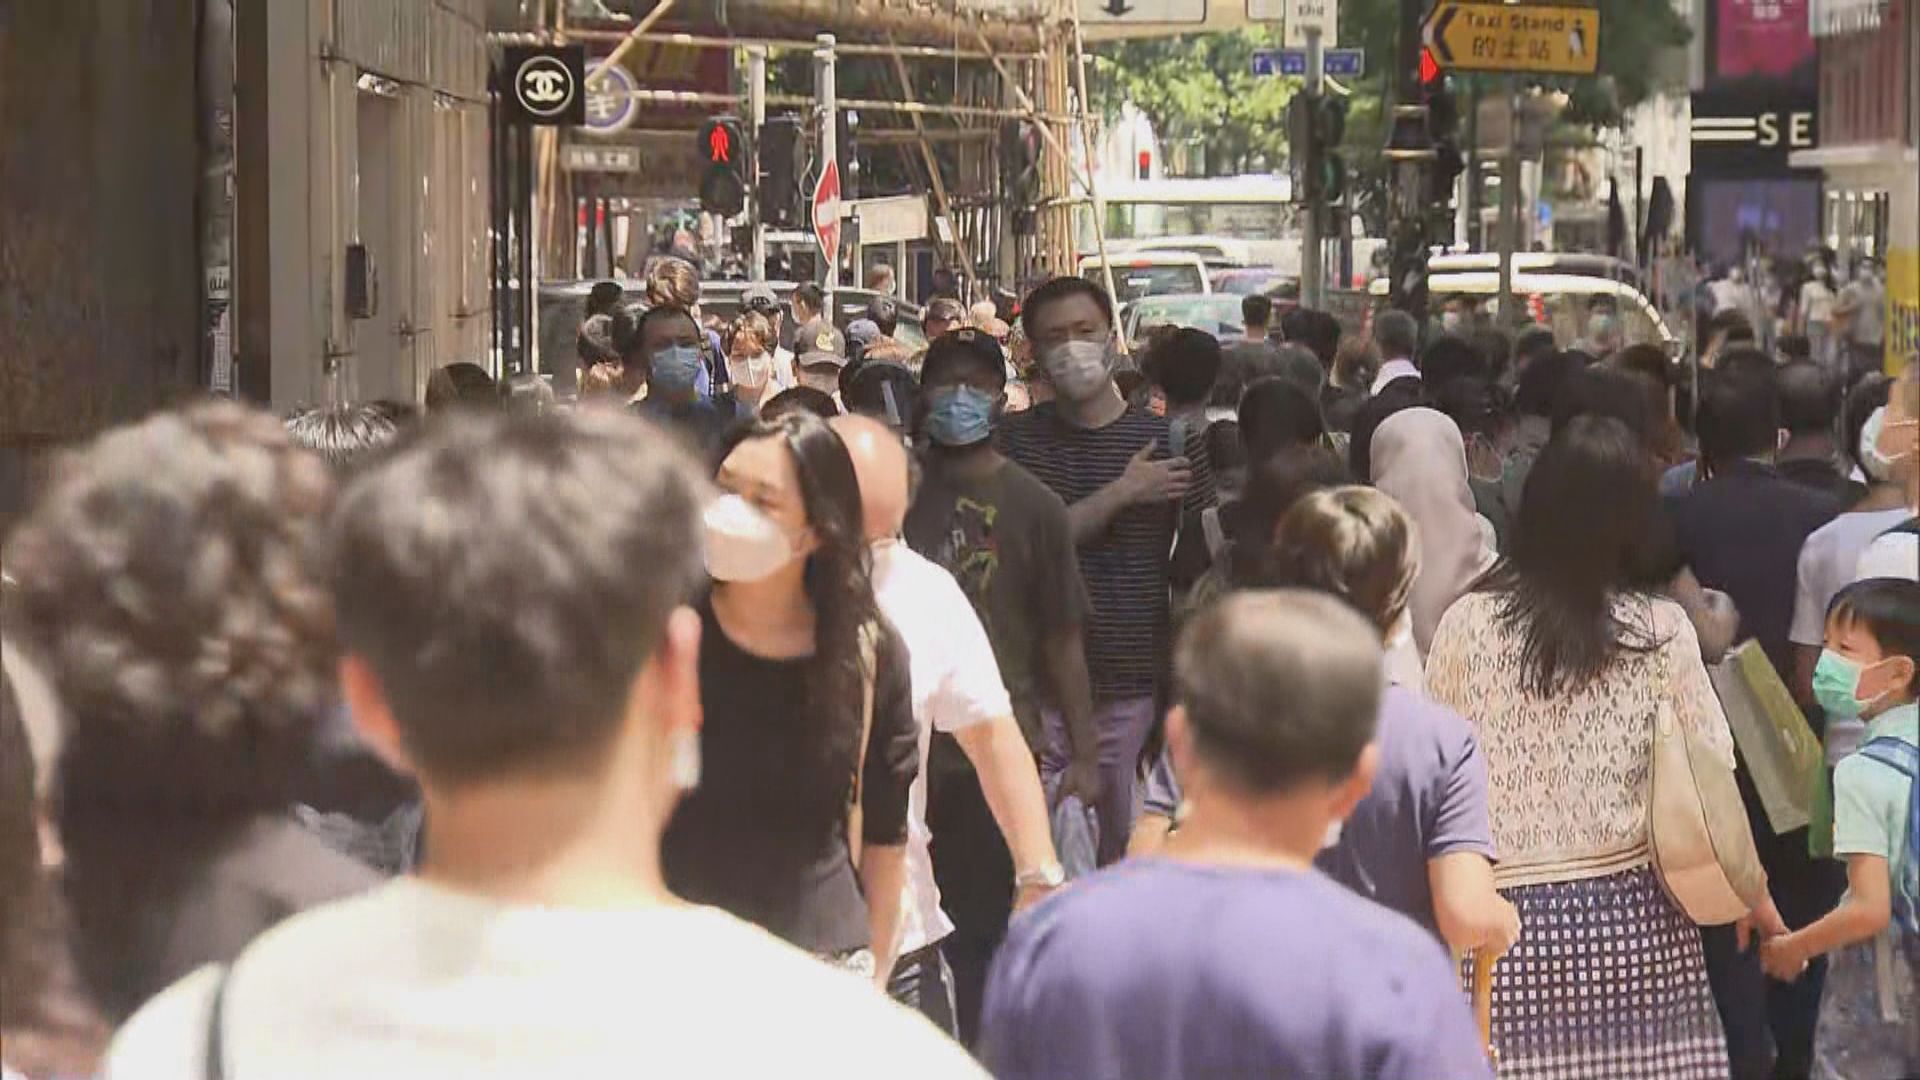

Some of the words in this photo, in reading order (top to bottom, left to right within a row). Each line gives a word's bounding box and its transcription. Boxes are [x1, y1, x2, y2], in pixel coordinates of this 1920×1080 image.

[1465, 12, 1502, 28] Taxi
[1509, 13, 1565, 32] Stand
[1473, 35, 1550, 60] 的士站
